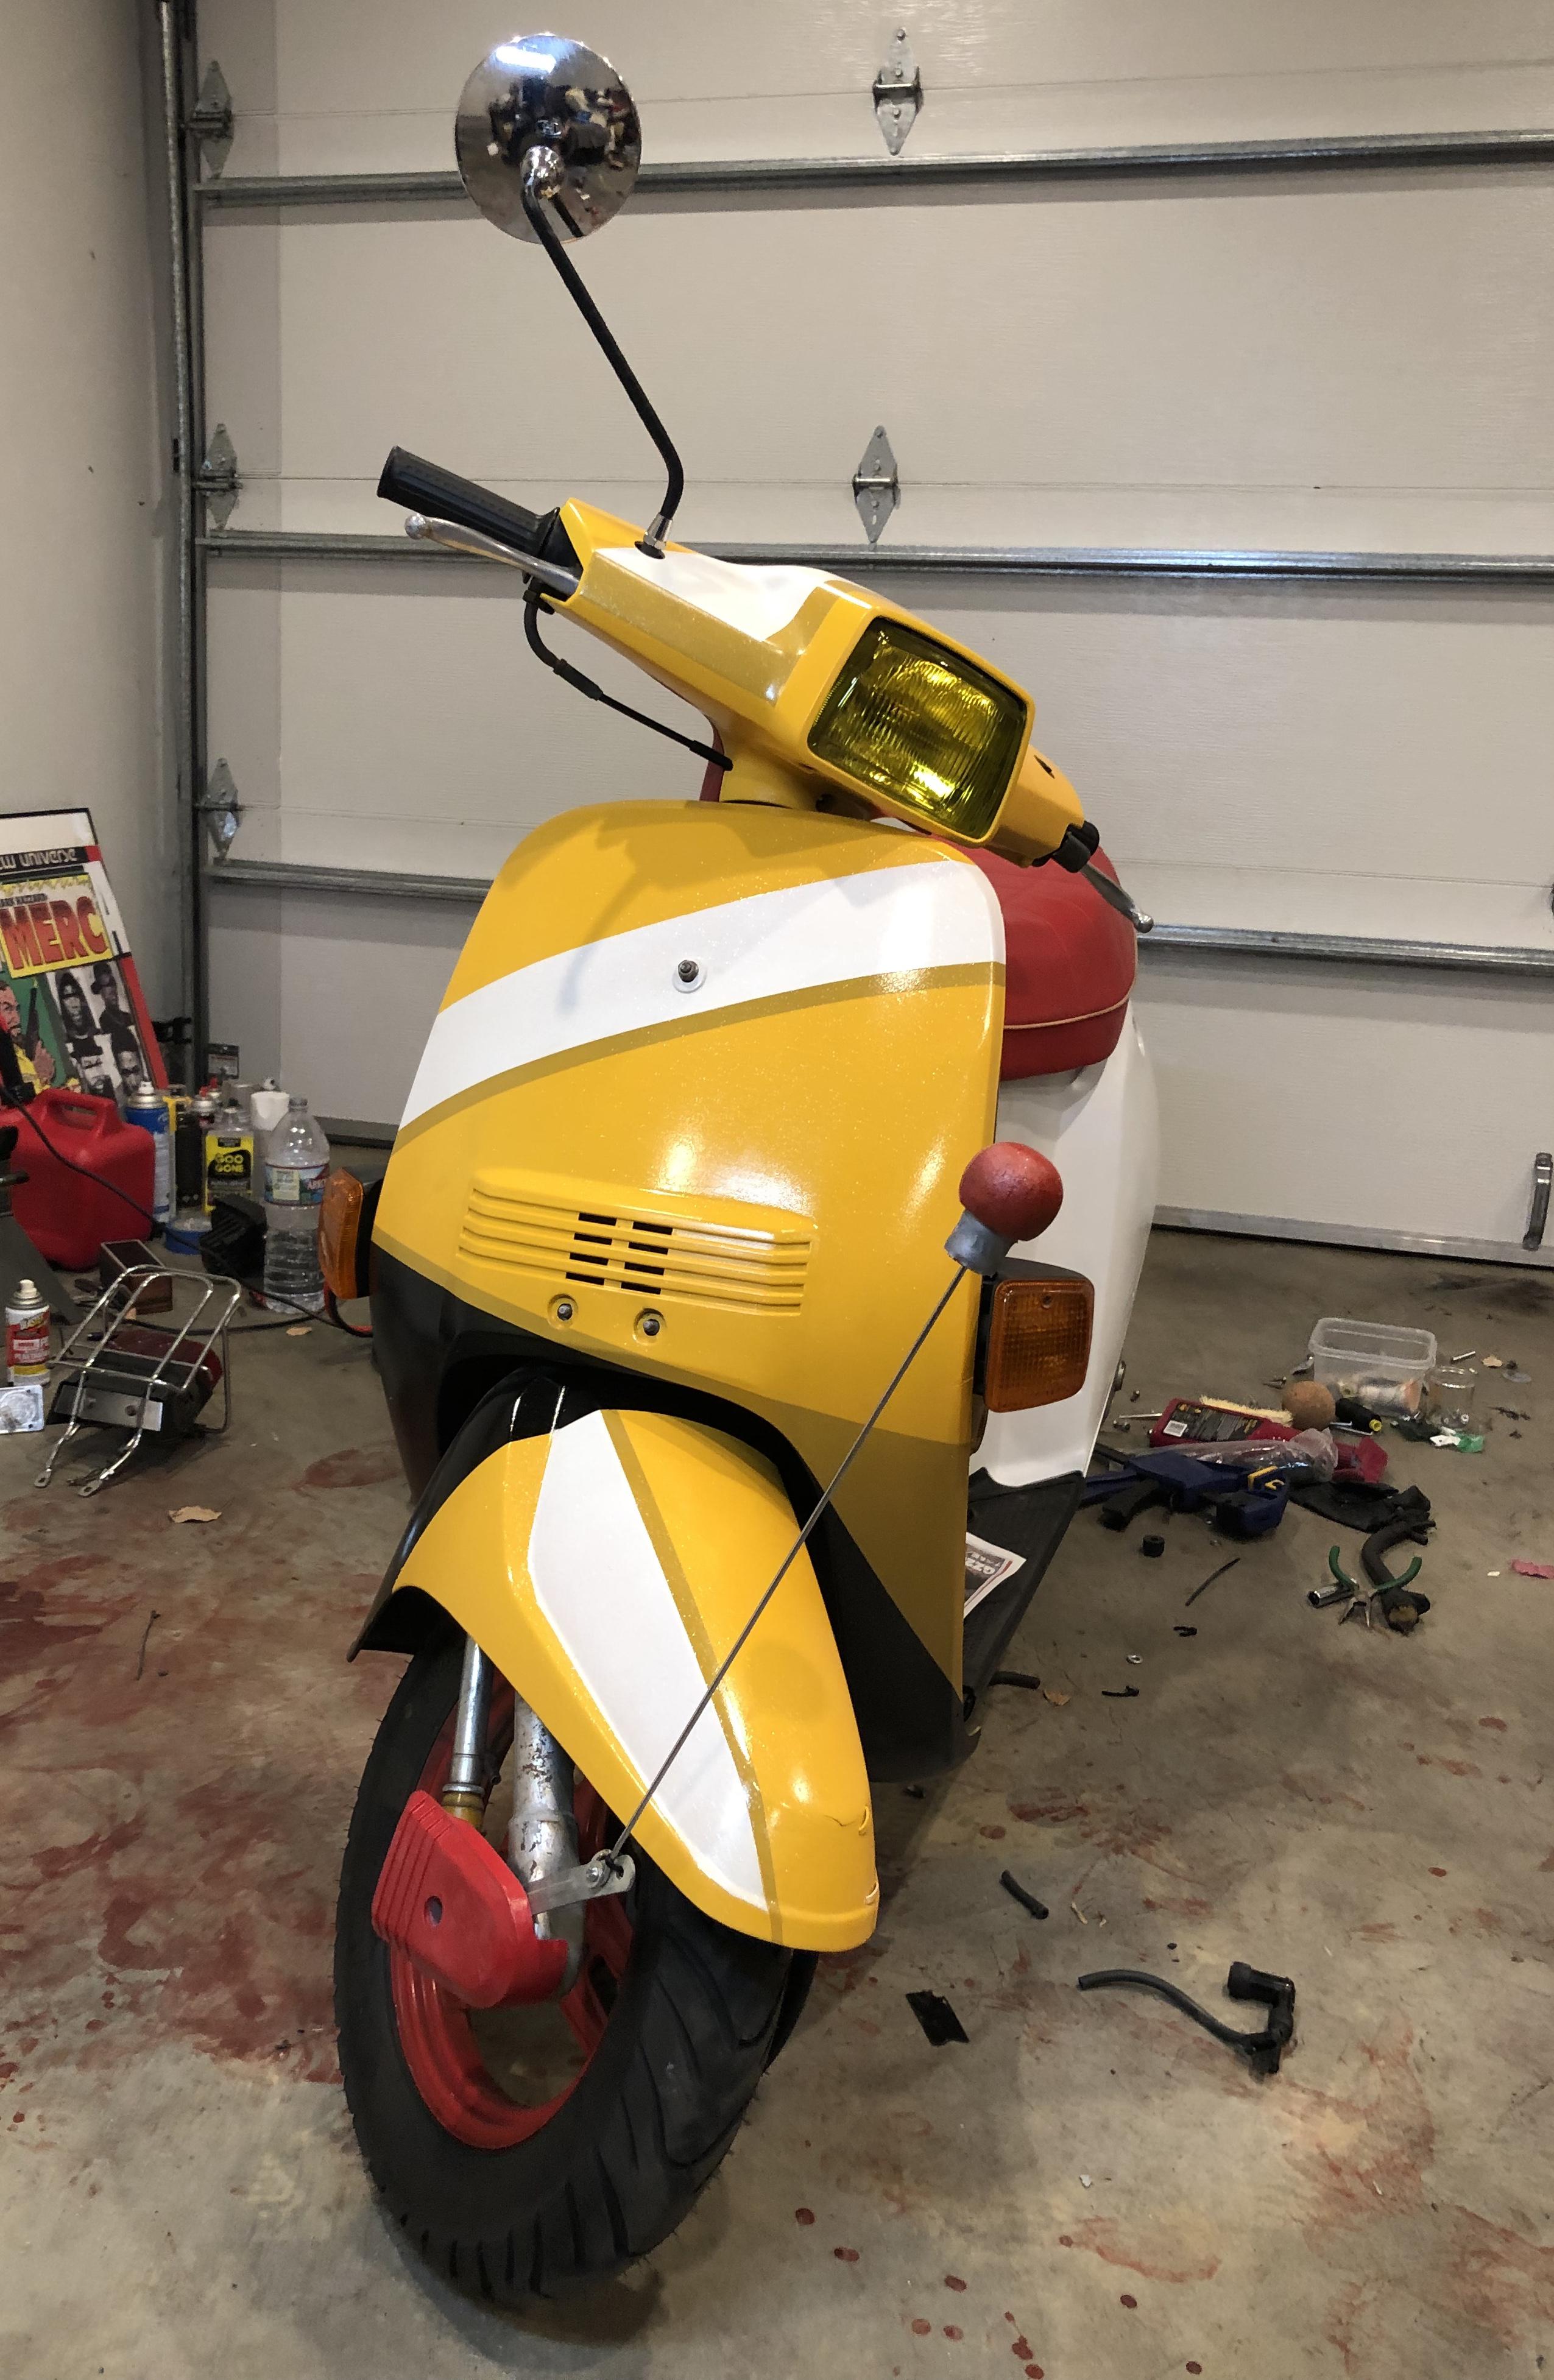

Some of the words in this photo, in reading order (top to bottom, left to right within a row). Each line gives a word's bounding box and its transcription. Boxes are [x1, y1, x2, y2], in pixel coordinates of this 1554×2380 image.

[0, 895, 108, 970] MERC
[214, 1153, 244, 1165] GOO
[214, 1164, 244, 1173] GONE
